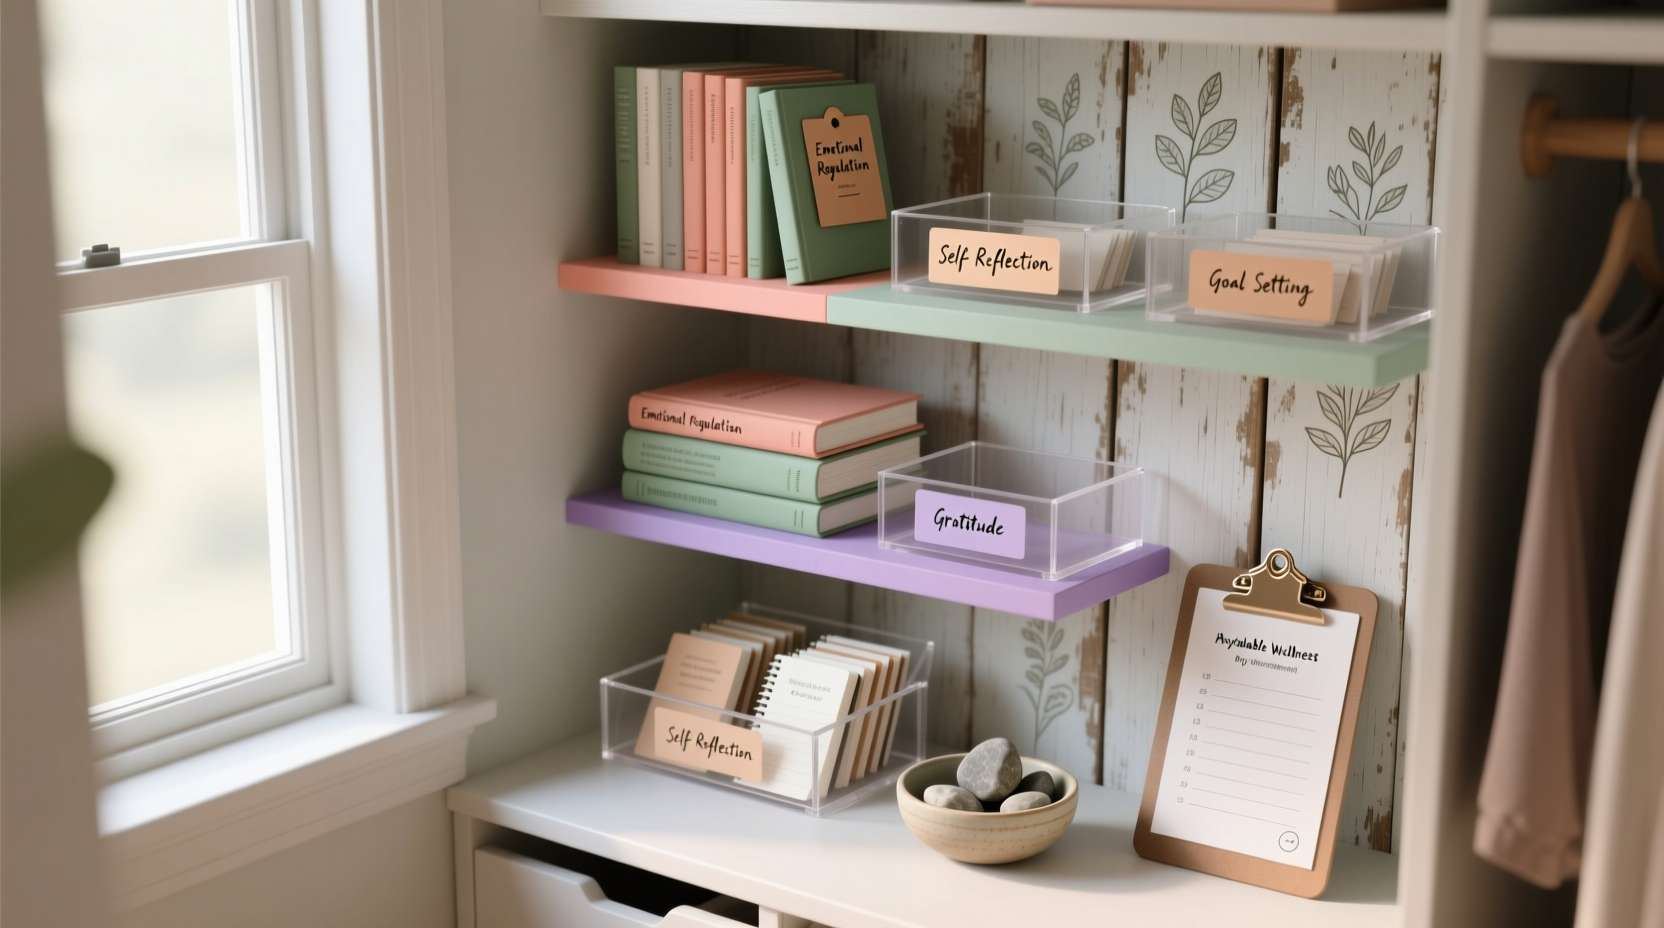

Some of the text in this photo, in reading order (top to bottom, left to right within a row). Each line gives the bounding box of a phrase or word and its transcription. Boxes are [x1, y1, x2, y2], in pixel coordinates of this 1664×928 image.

[939, 244, 1053, 277] Self Reflection
[1209, 268, 1314, 307] Goal Setting
[934, 507, 1004, 535] Gratitude
[666, 726, 753, 760] Self Reflection
